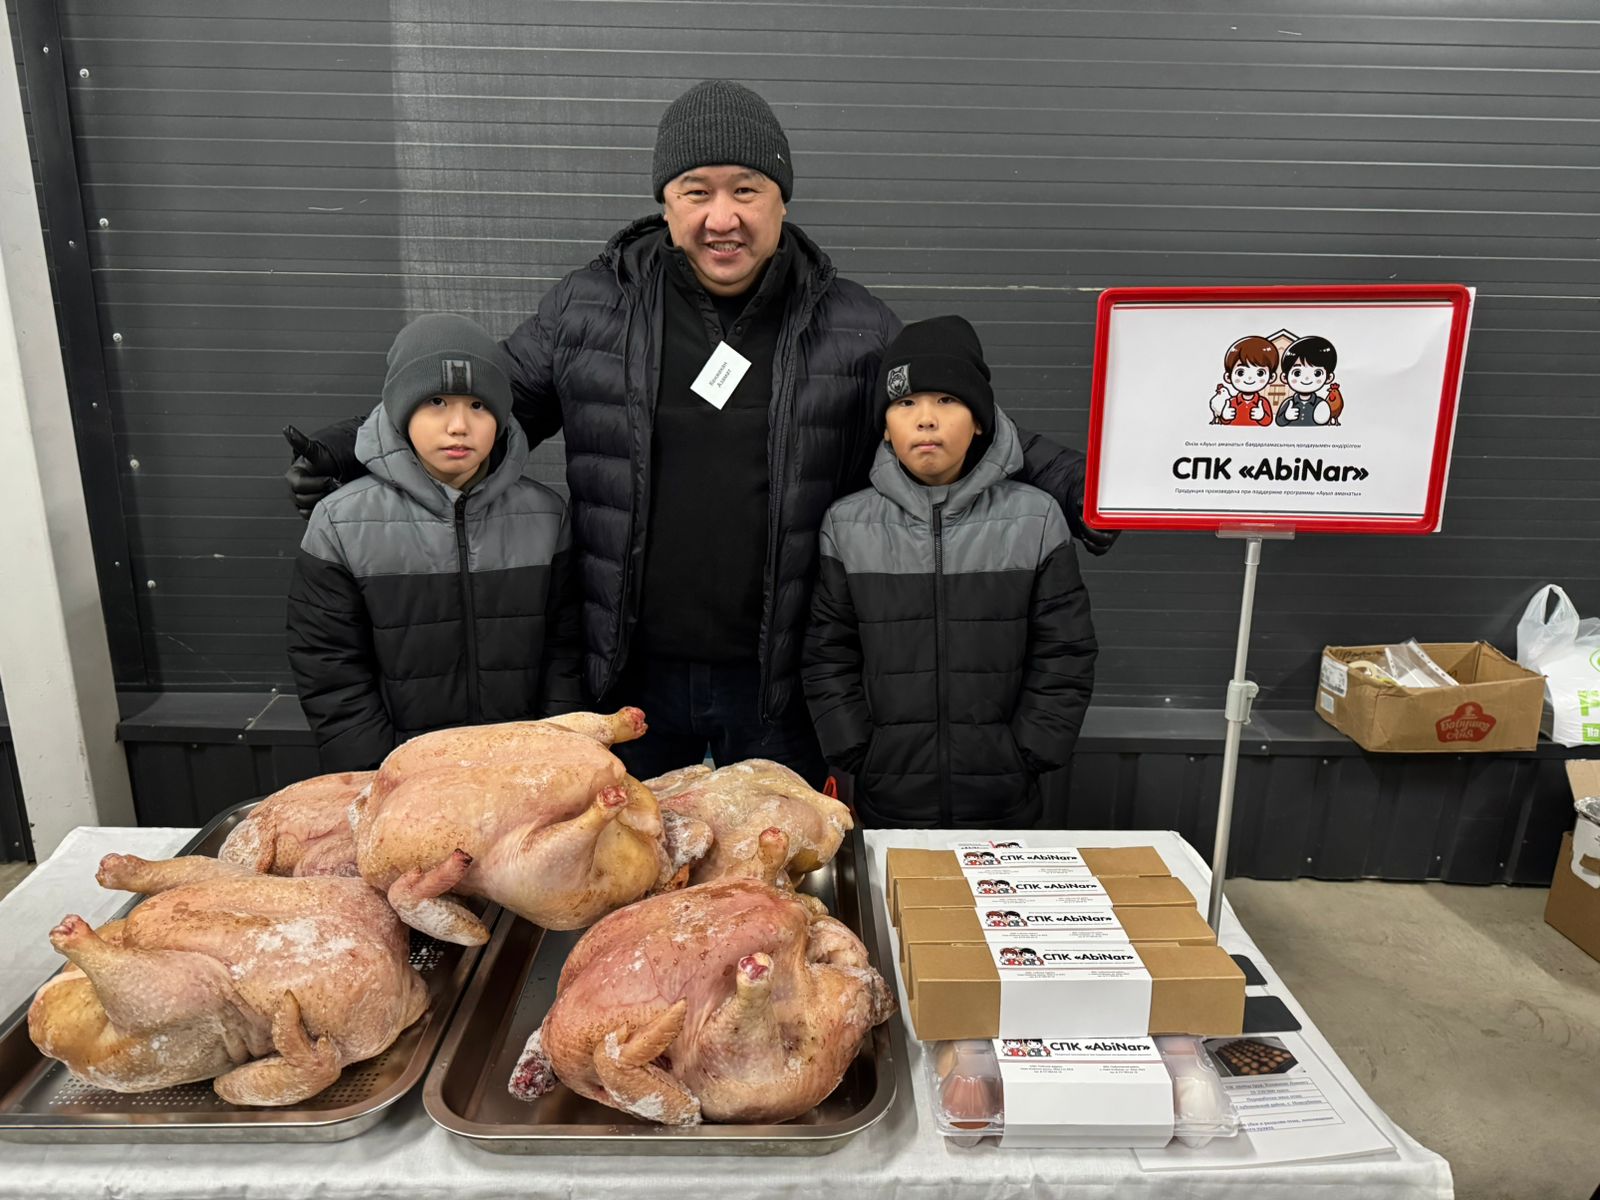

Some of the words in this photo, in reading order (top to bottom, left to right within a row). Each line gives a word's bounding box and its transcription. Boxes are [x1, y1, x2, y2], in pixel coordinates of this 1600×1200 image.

[1172, 457, 1232, 480] СПК
[1238, 457, 1369, 482] «AbiNar»
[1042, 953, 1072, 961] СПК
[1074, 953, 1134, 961] «AbiNar»
[1050, 1042, 1082, 1051] СПК
[1084, 1041, 1151, 1052] «AbiNar»
